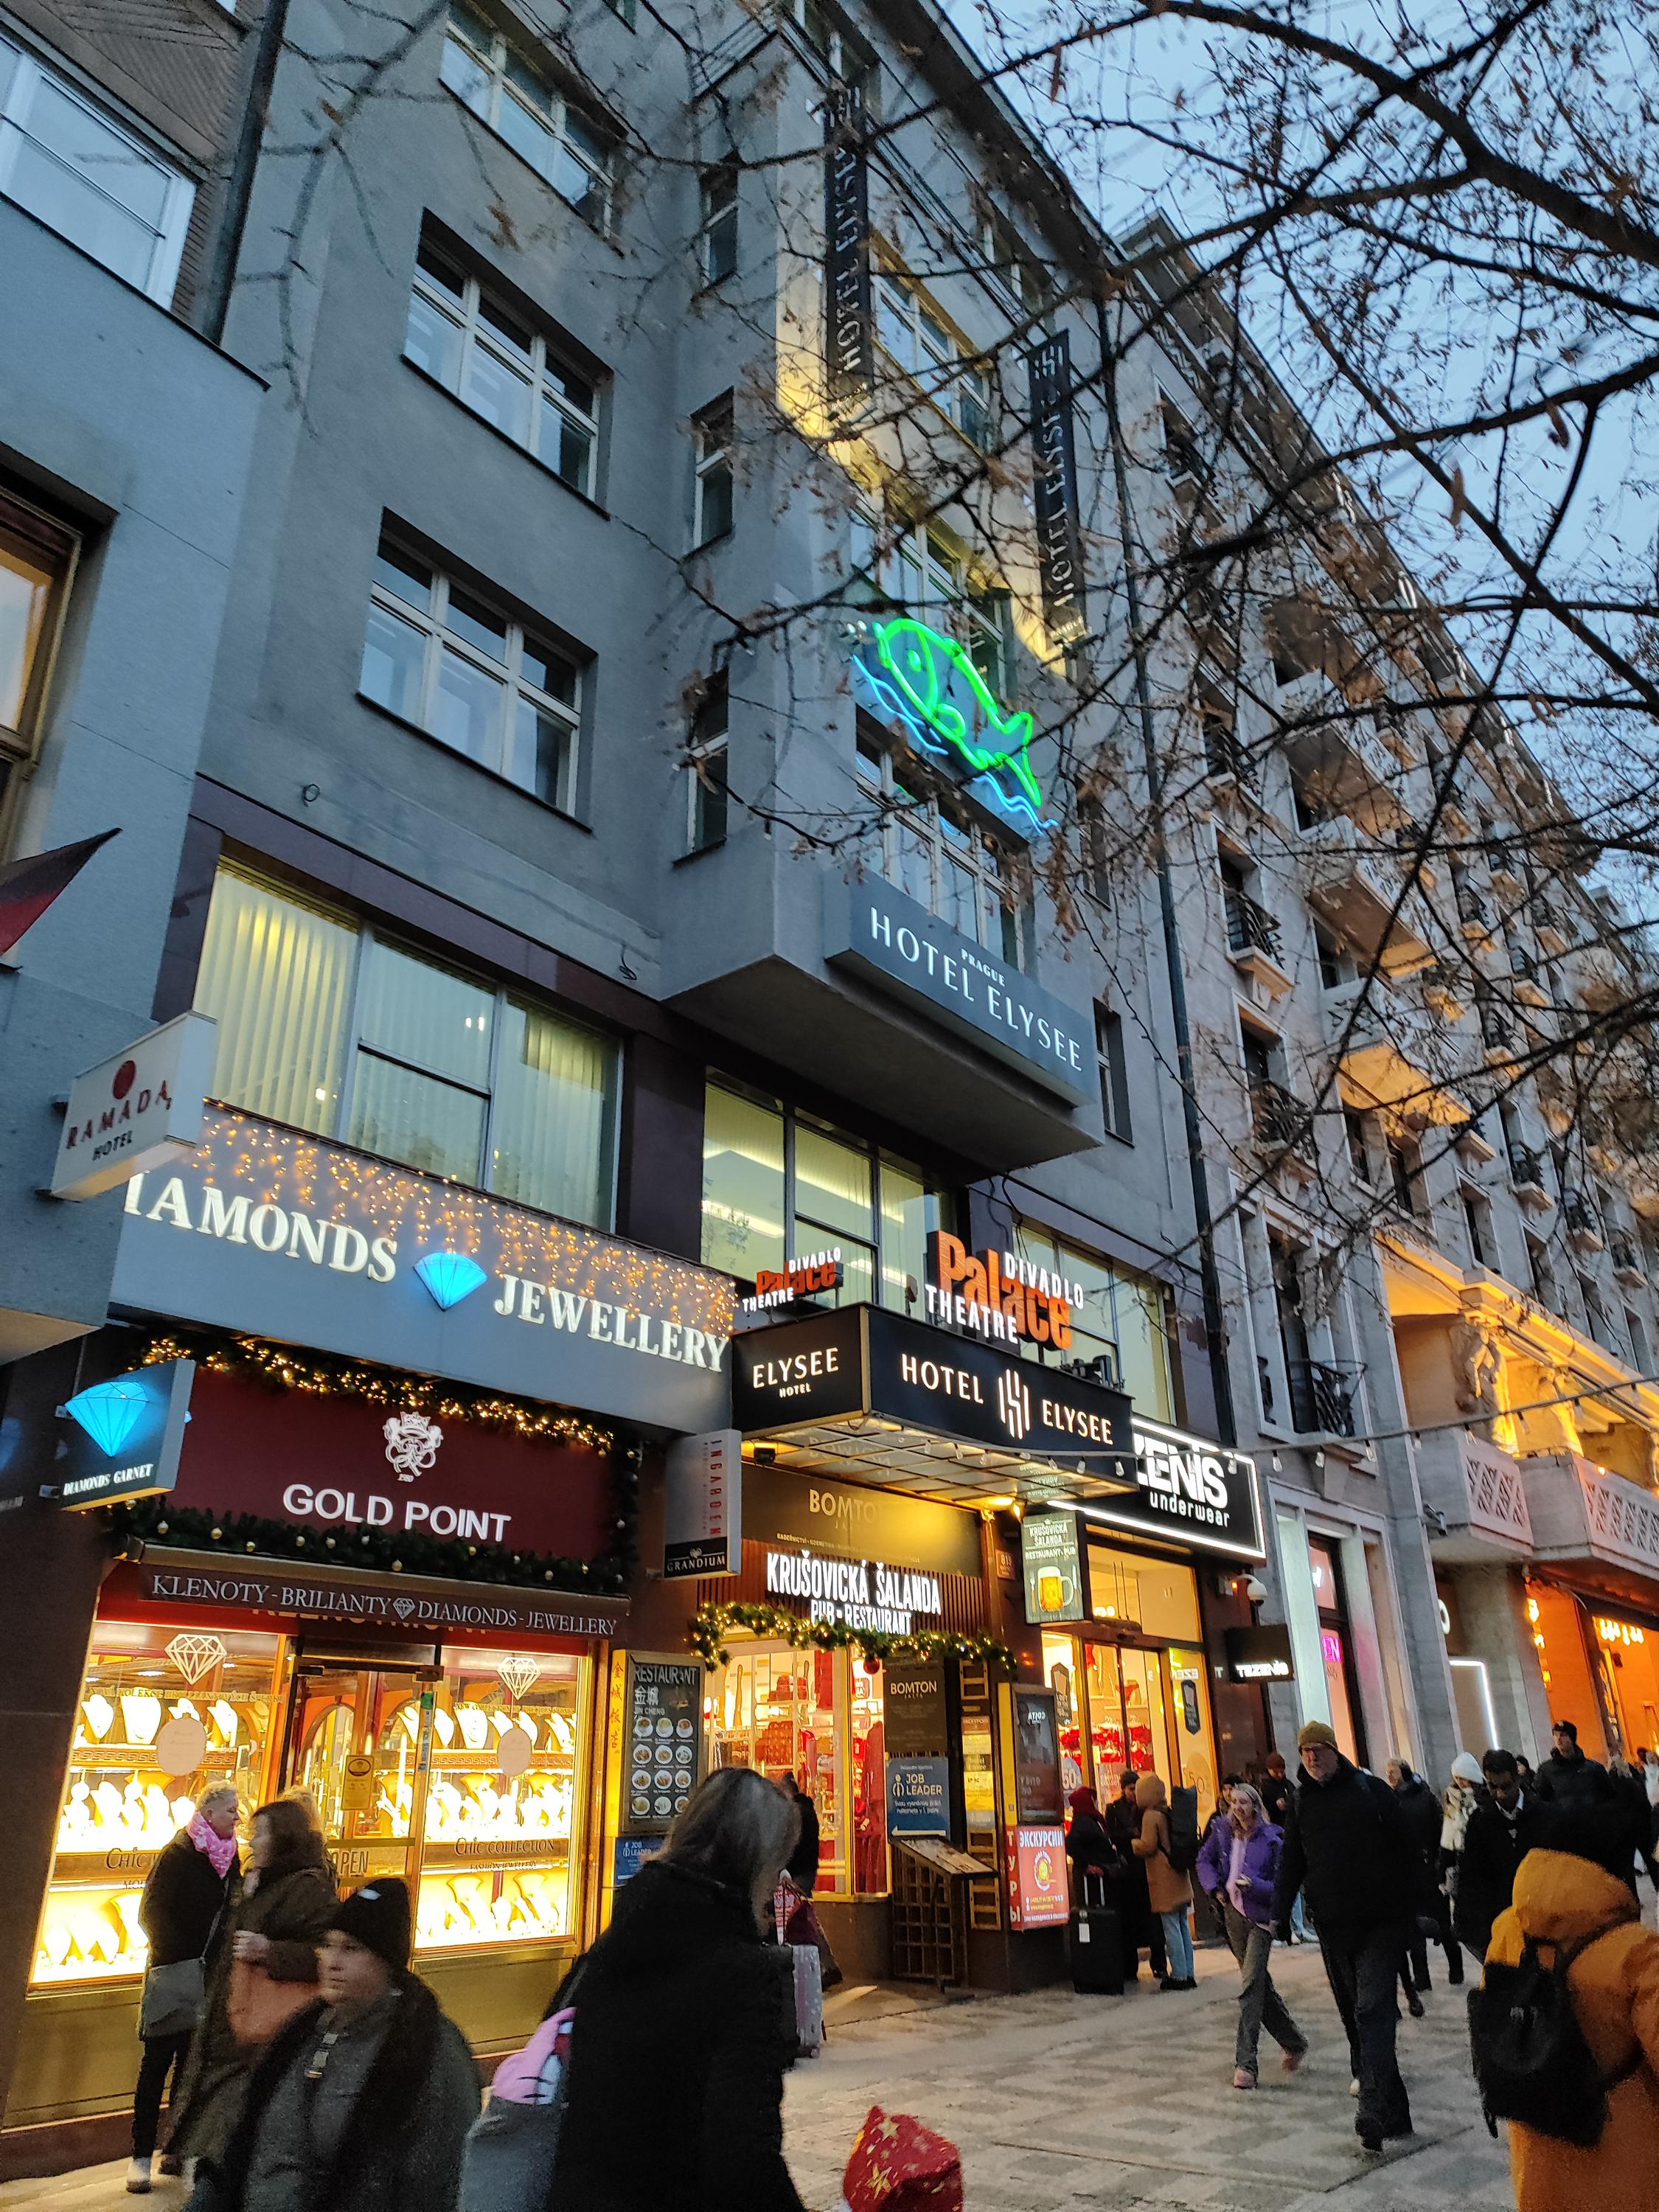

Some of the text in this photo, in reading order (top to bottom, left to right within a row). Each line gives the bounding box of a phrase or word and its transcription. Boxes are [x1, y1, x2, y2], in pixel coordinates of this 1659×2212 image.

[961, 948, 1006, 987] PRAGUE
[870, 906, 1082, 1071] HOTEL ELYSEE
[66, 1079, 173, 1150] RAMADA
[91, 1130, 133, 1161] HOTEL
[788, 1246, 841, 1274] DIVADLO
[755, 1262, 838, 1298] Palace
[936, 1228, 1074, 1352] Palace
[1004, 1251, 1085, 1310] DIVADLO
[742, 1287, 795, 1312] THEATRE
[924, 1283, 1019, 1344] THEATRE
[493, 1273, 729, 1373] JEWELLERY
[752, 1347, 839, 1389] ELYSEE
[779, 1382, 812, 1399] HOTEL
[901, 1353, 1114, 1446] HOTEL ELYSEE
[62, 1463, 154, 1497] DIAMONDS GARNET
[282, 1484, 512, 1543] GOLD POINT
[809, 1489, 877, 1524] BOMTO
[1150, 1491, 1231, 1528] underwear
[667, 1554, 726, 1573] GRANDIUM
[767, 1549, 942, 1616] KRUŠOVICKÁ ŠALANDA
[152, 1574, 271, 1604] KLENOTY
[280, 1587, 392, 1615] BRILIANTY
[417, 1600, 518, 1627] DIAMONDS
[526, 1611, 617, 1635] JEWELLERY
[810, 1599, 913, 1636] PUB RESTAURANT
[634, 1665, 698, 1686] RESTAURANT
[1235, 1660, 1290, 1678] TEZENIS
[890, 1680, 937, 1695] BOMTON
[905, 1773, 925, 1784] JOB
[906, 1784, 943, 1797] LEADER
[1018, 1829, 1064, 1848] ЭКСКУРСИИ
